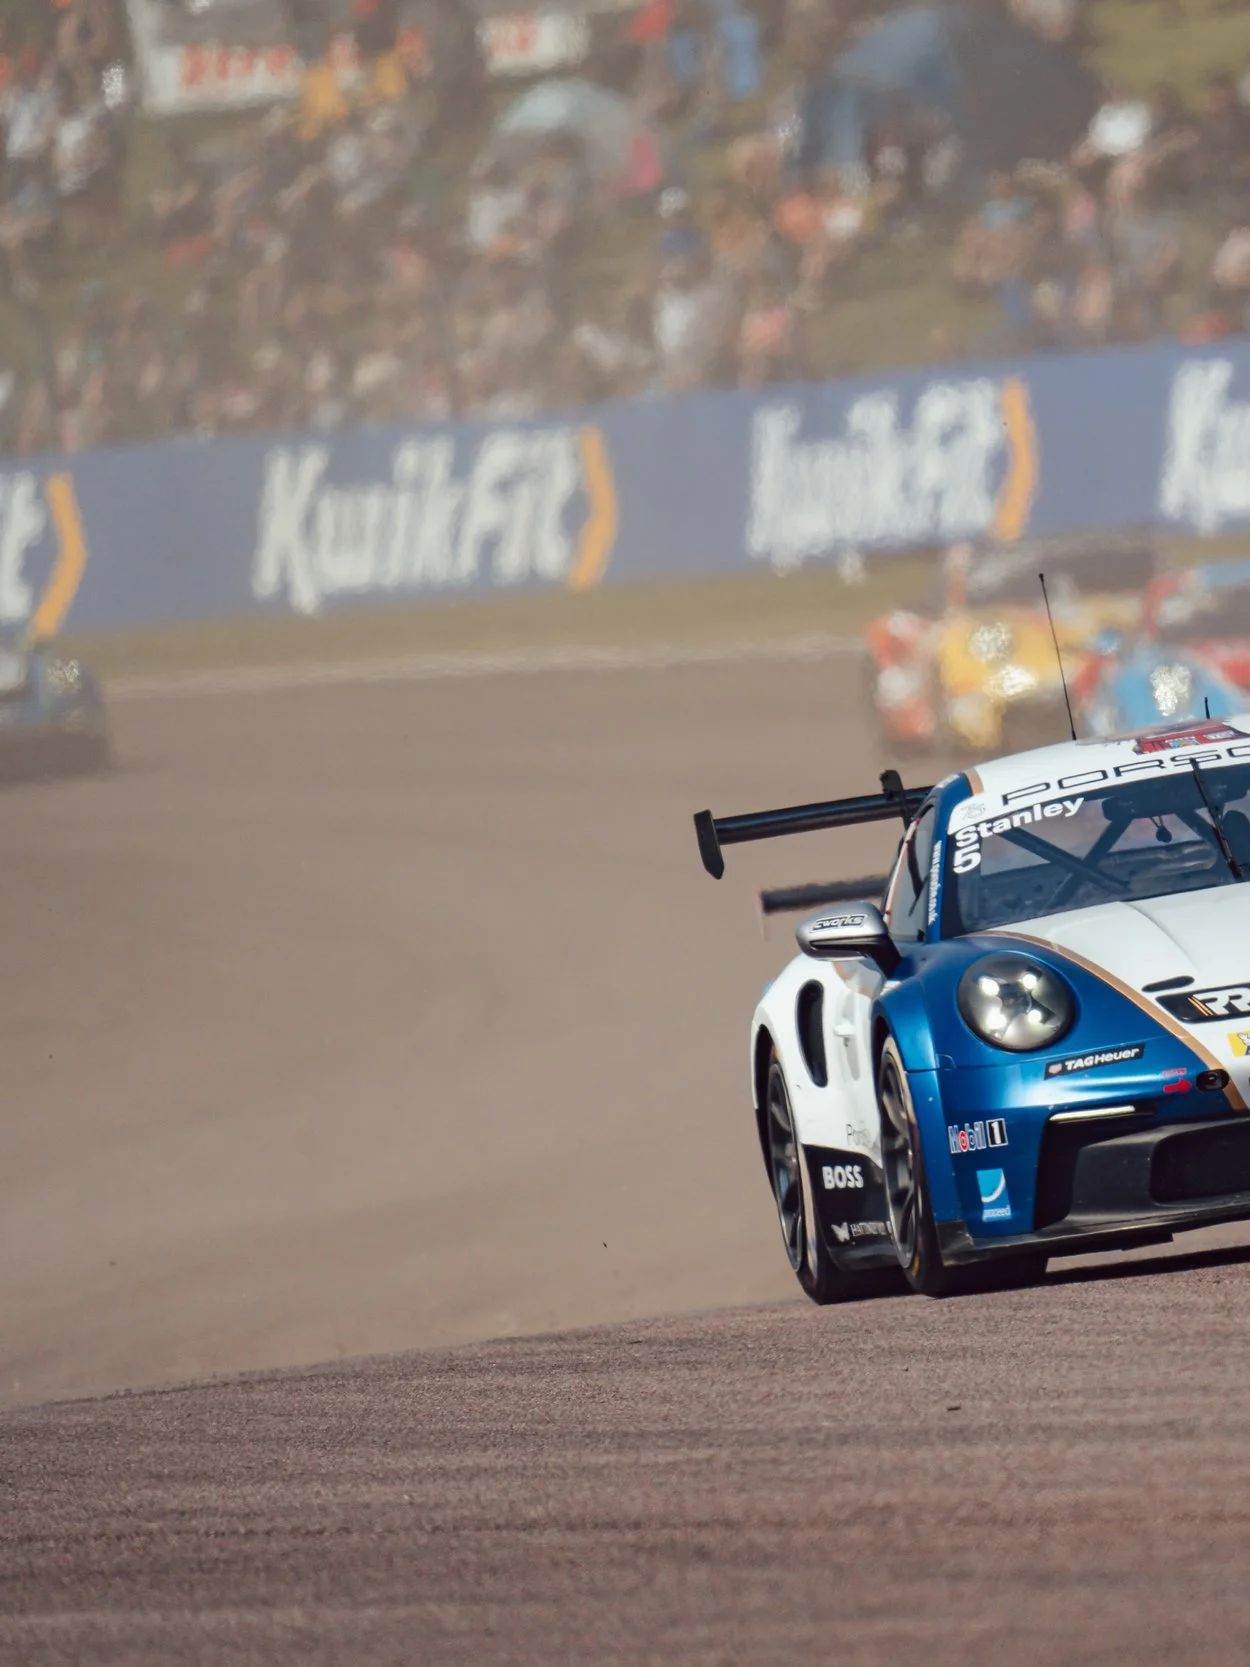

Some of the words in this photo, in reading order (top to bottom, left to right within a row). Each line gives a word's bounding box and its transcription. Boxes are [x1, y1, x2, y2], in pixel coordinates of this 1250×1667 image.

[955, 797, 1085, 848] Stanley
[953, 843, 982, 874] 5
[948, 1120, 987, 1154] Mobil
[989, 1120, 1004, 1146] 1
[822, 1165, 864, 1190] BOSS
